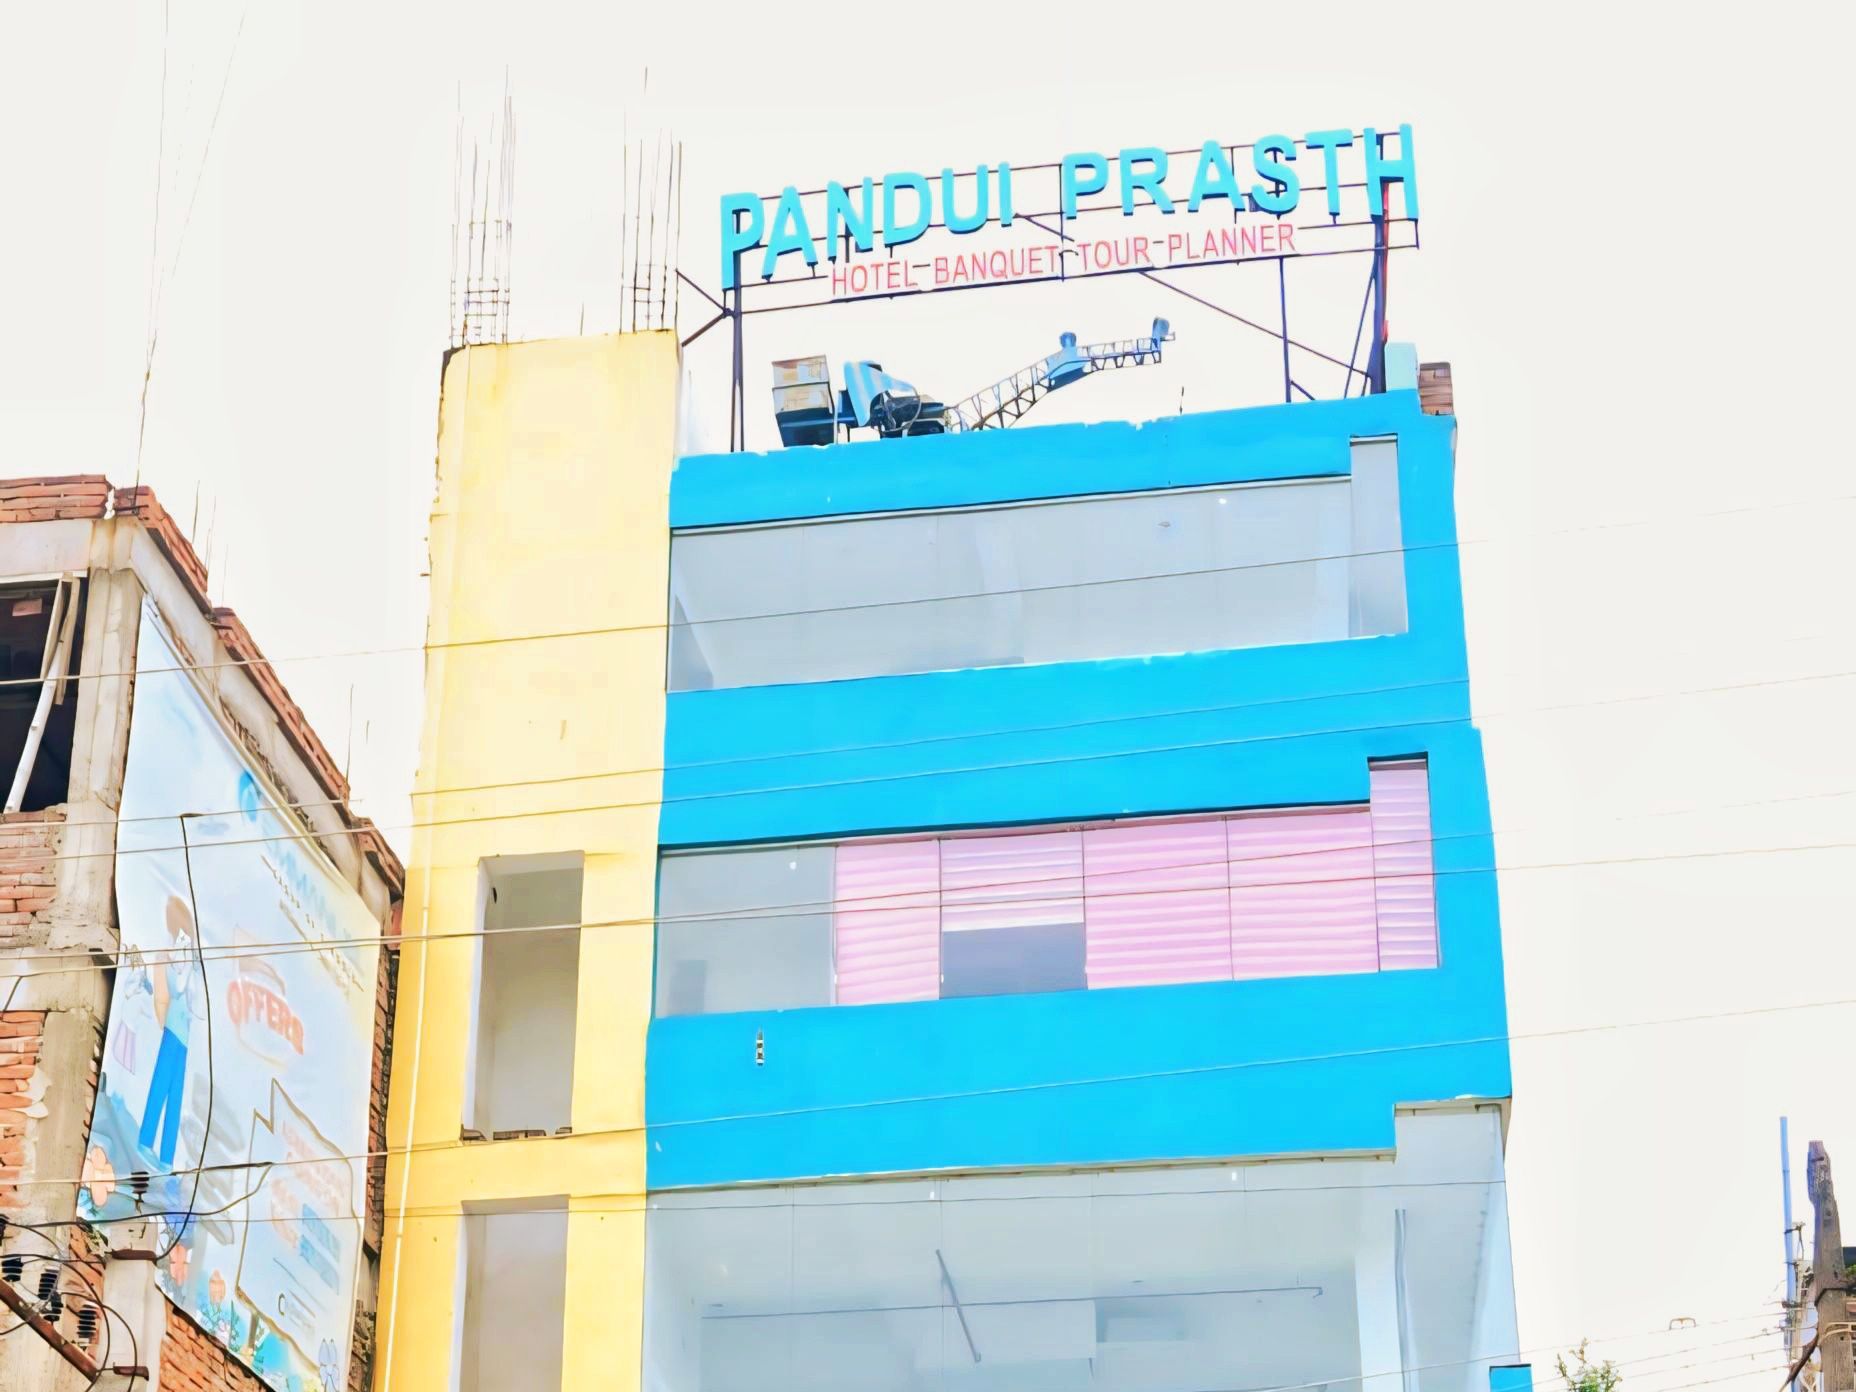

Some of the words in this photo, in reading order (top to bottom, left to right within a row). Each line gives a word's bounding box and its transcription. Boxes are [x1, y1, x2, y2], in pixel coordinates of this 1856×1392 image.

[720, 162, 1017, 290] PANDUI
[1062, 123, 1419, 220] PRASTH
[832, 261, 917, 296] HOTEL
[935, 246, 1059, 284] BANQUET
[1077, 236, 1150, 271] TOUR
[1167, 224, 1297, 260] PLANNER
